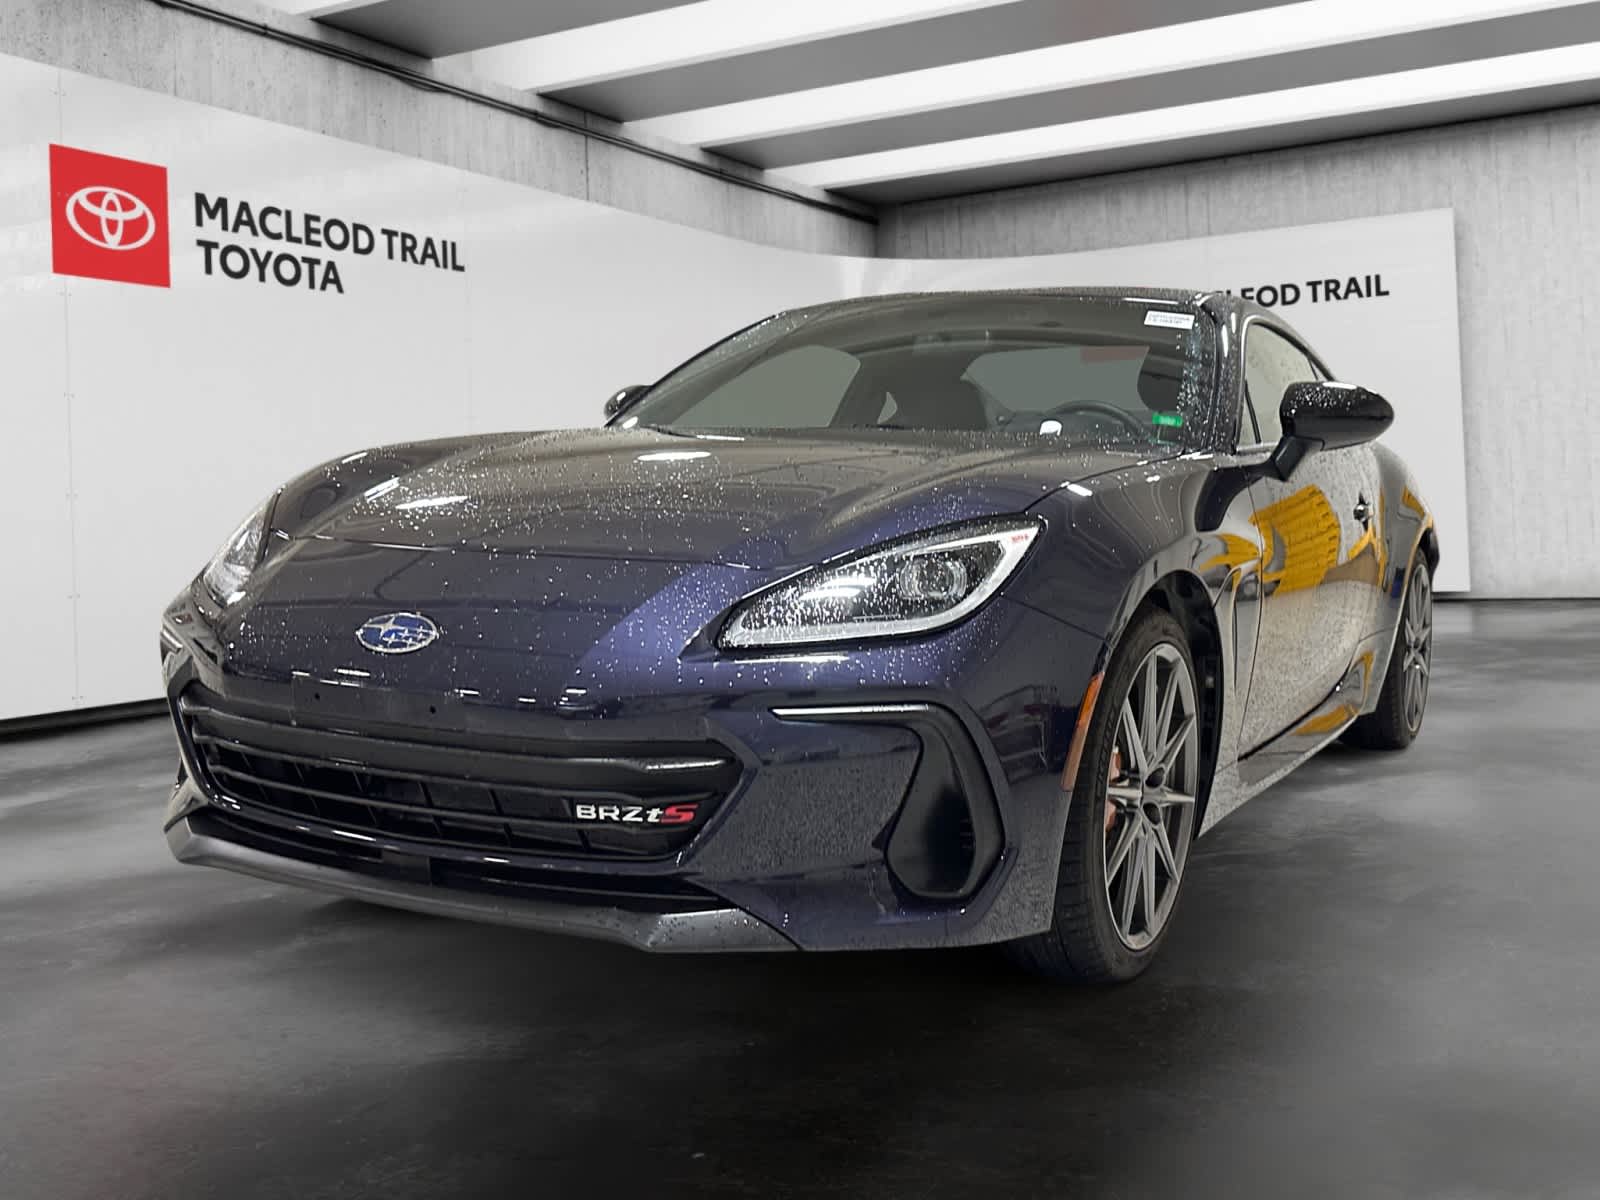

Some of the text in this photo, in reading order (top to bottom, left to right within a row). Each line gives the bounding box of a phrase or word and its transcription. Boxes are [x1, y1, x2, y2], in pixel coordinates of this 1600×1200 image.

[194, 191, 466, 273] MACLEOD TRAIL
[196, 239, 344, 294] TOYOTA
[1305, 274, 1390, 303] TRAIL
